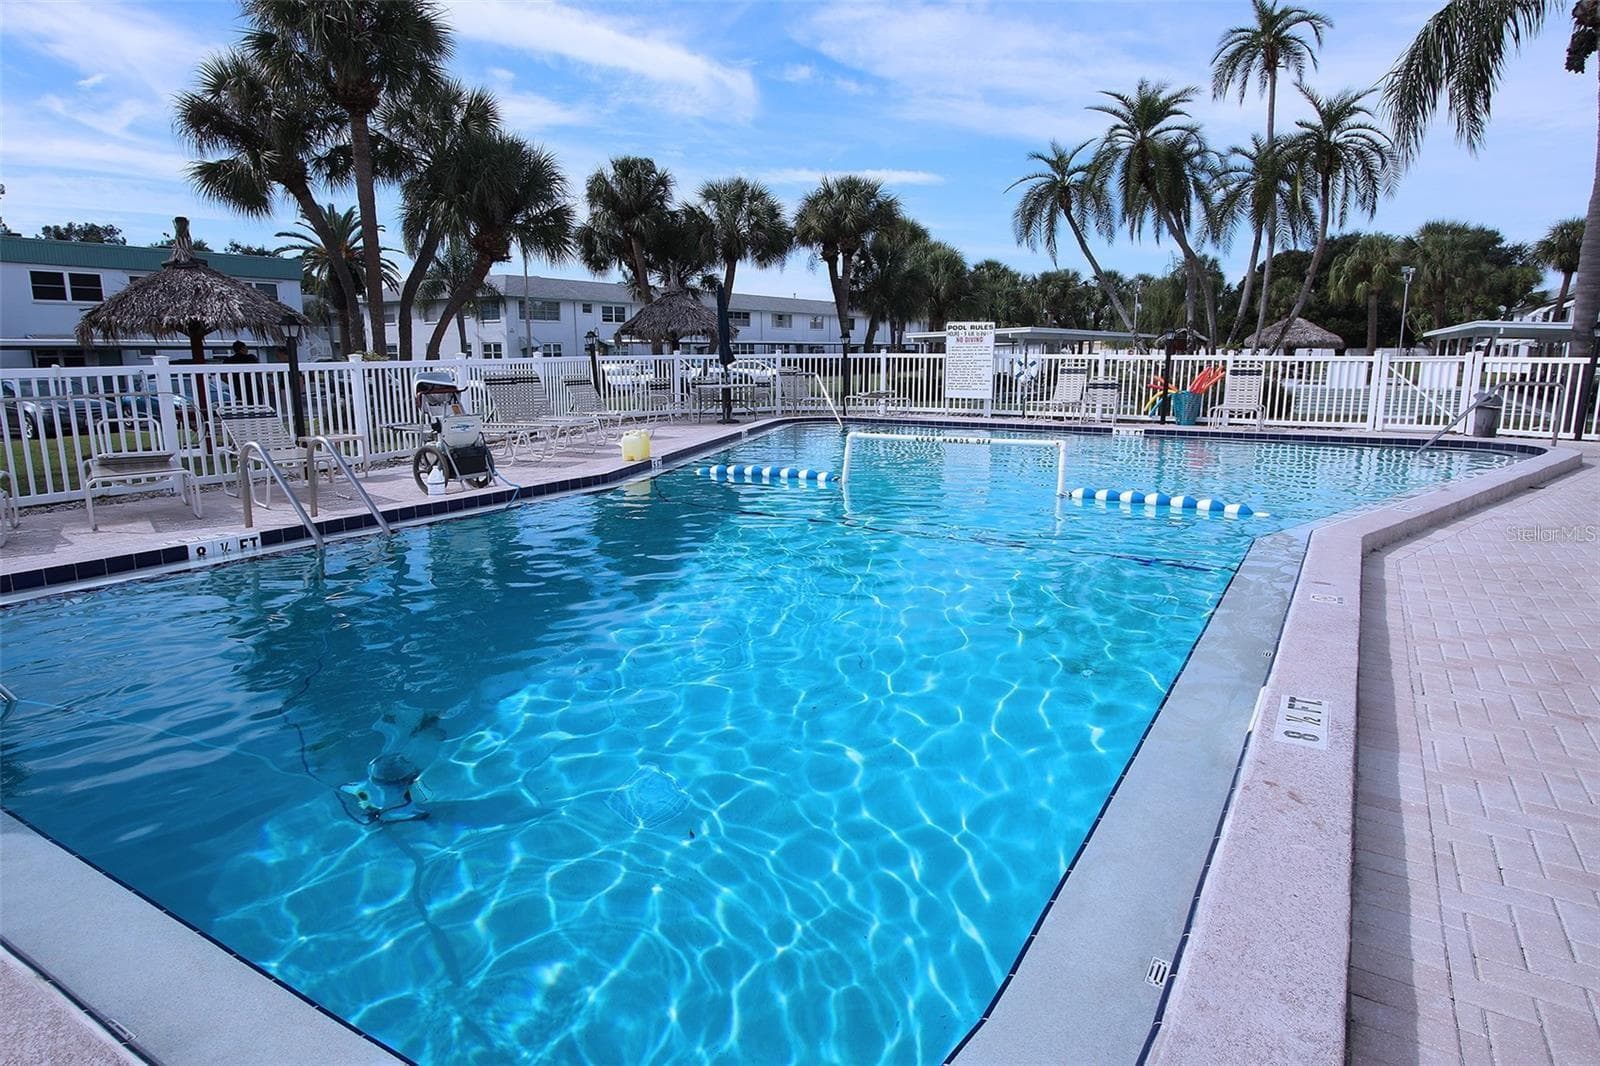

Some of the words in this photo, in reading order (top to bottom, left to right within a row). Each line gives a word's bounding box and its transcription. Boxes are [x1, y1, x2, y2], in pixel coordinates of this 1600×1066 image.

[239, 537, 259, 550] FT
[1287, 696, 1323, 714] FT
[1283, 730, 1320, 742] 8
